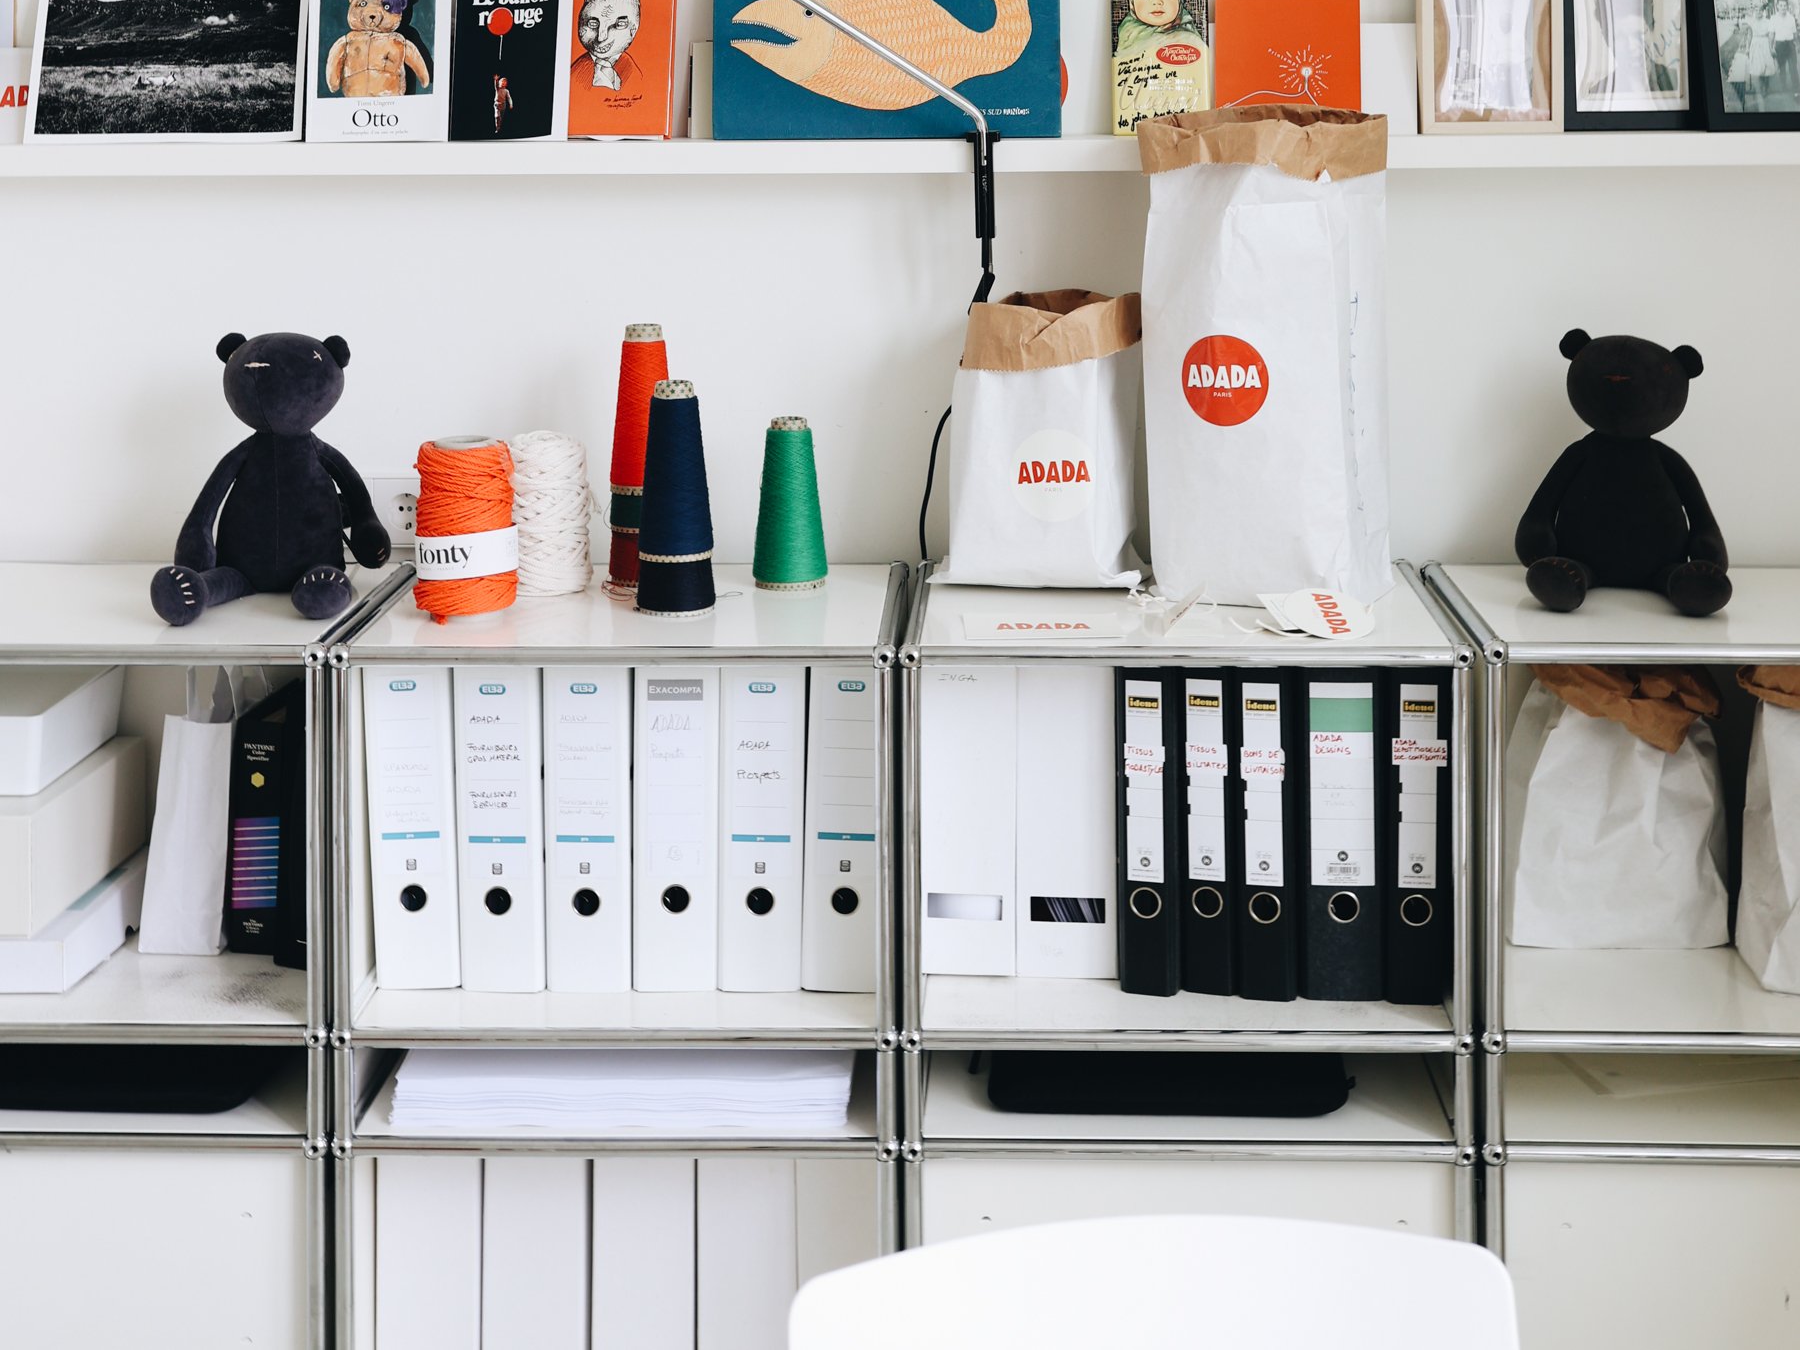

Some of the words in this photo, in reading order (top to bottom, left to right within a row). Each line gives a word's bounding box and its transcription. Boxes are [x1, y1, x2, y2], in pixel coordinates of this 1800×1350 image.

[352, 108, 399, 128] Otto
[1187, 364, 1262, 389] ADADA
[1017, 460, 1091, 484] ADADA
[419, 542, 472, 569] fonty
[1311, 593, 1351, 635] ADADA
[996, 622, 1091, 630] ADADA
[1129, 698, 1158, 708] idena
[1190, 696, 1218, 707] idena
[1247, 700, 1276, 710] idena
[1404, 701, 1434, 711] idena
[469, 715, 501, 725] ADADA
[1313, 734, 1343, 742] ADADA
[244, 743, 275, 751] PANTONE
[737, 740, 771, 751] ADADA
[1243, 750, 1262, 758] BONS
[1268, 750, 1279, 758] DE
